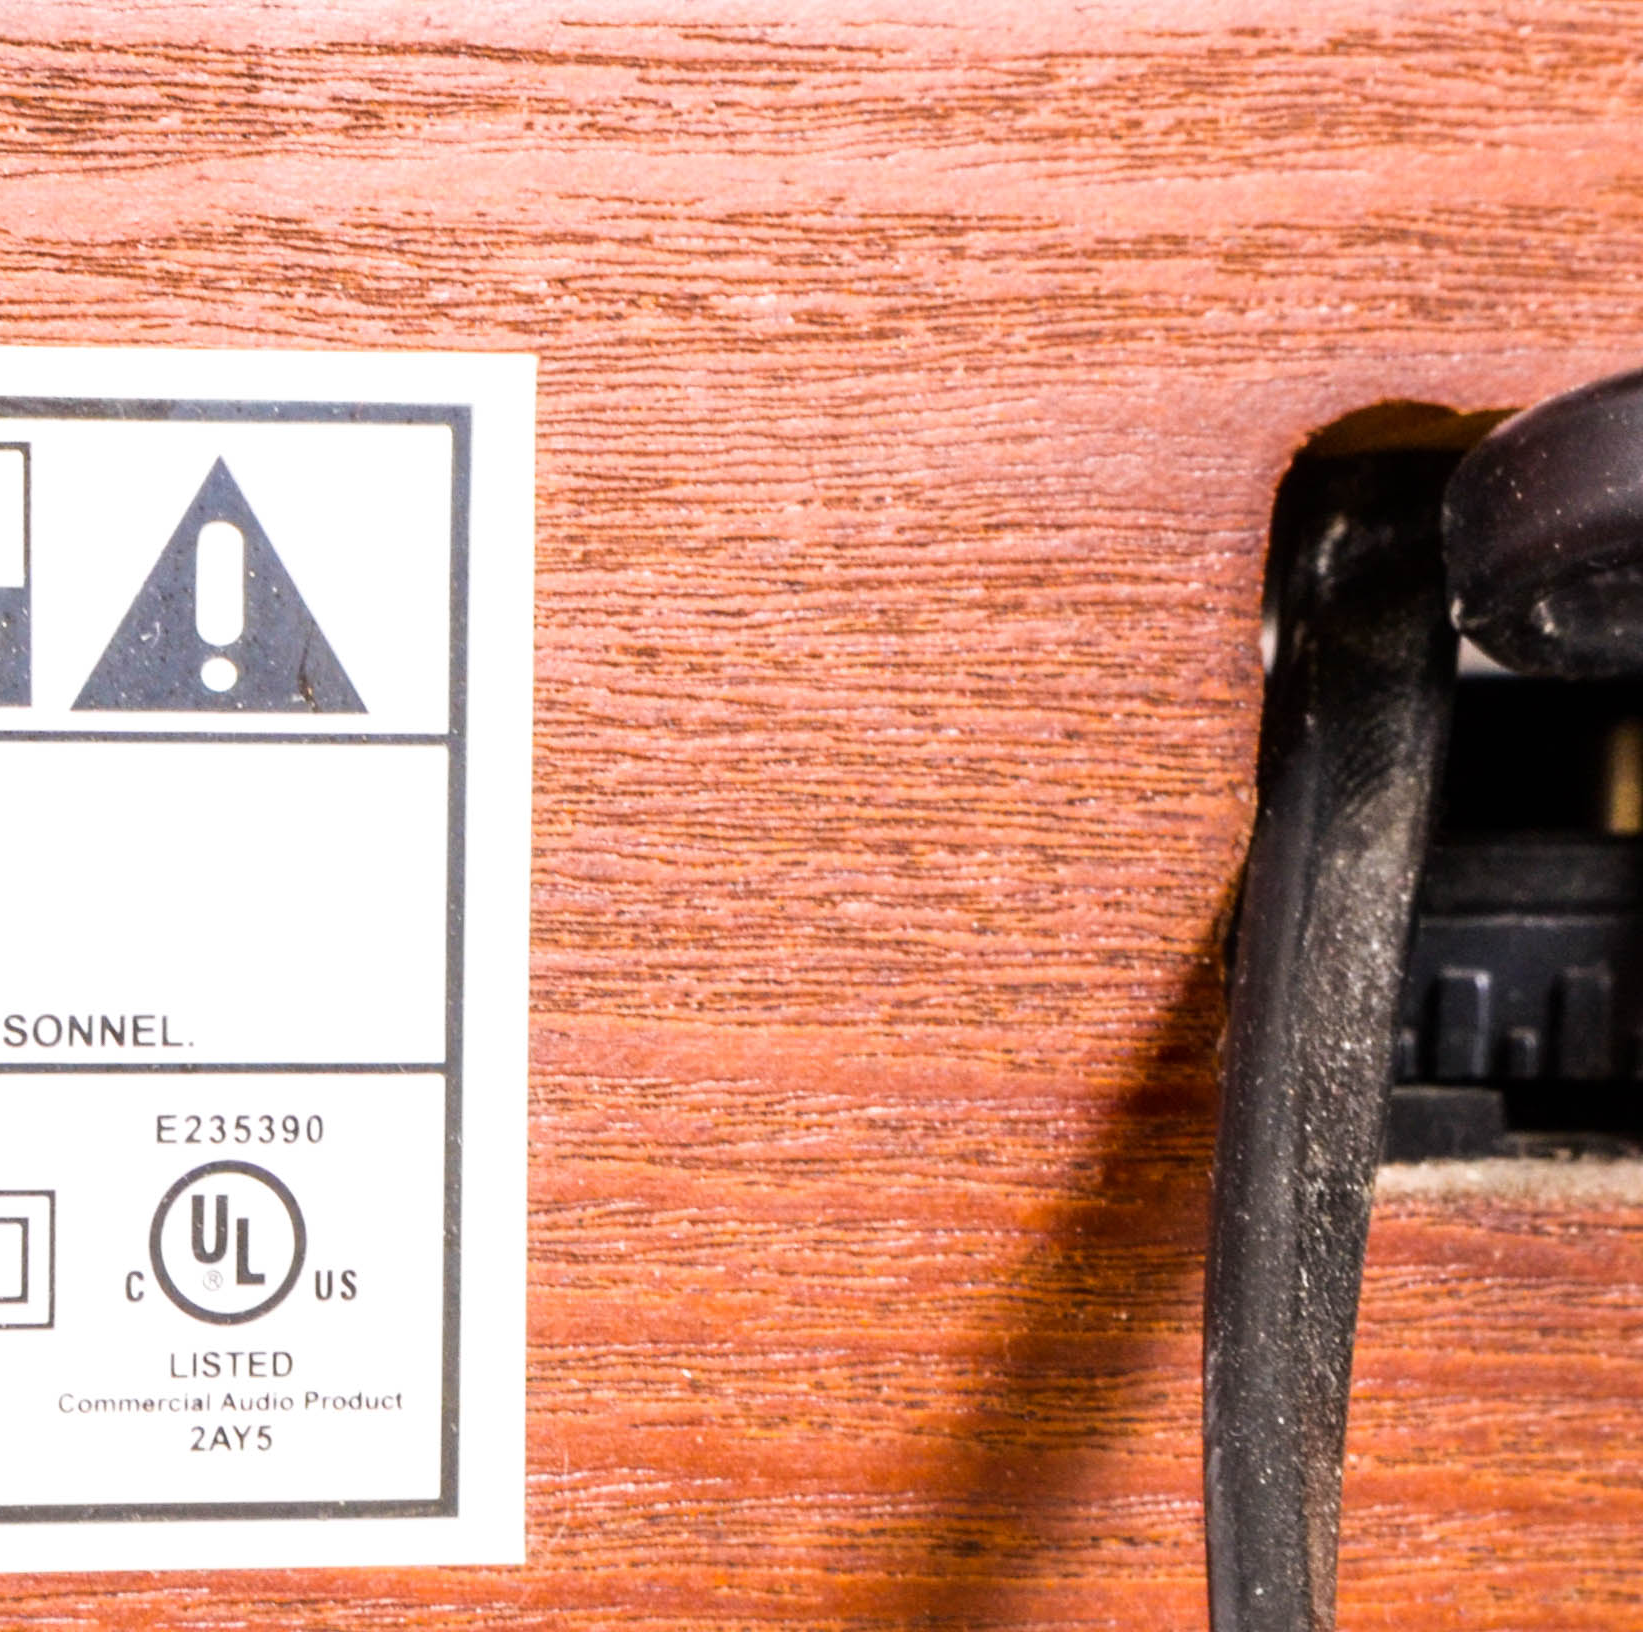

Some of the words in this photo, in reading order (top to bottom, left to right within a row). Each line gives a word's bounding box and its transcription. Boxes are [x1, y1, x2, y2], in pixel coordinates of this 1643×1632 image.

[155, 1113, 325, 1145] E235390
[190, 1193, 267, 1287] UL
[313, 1268, 359, 1303] US
[169, 1350, 294, 1379] LISTED
[57, 1392, 212, 1415] Commercial
[219, 1391, 296, 1413] Audio
[303, 1389, 404, 1412] Product
[189, 1424, 273, 1452] 2AY5
